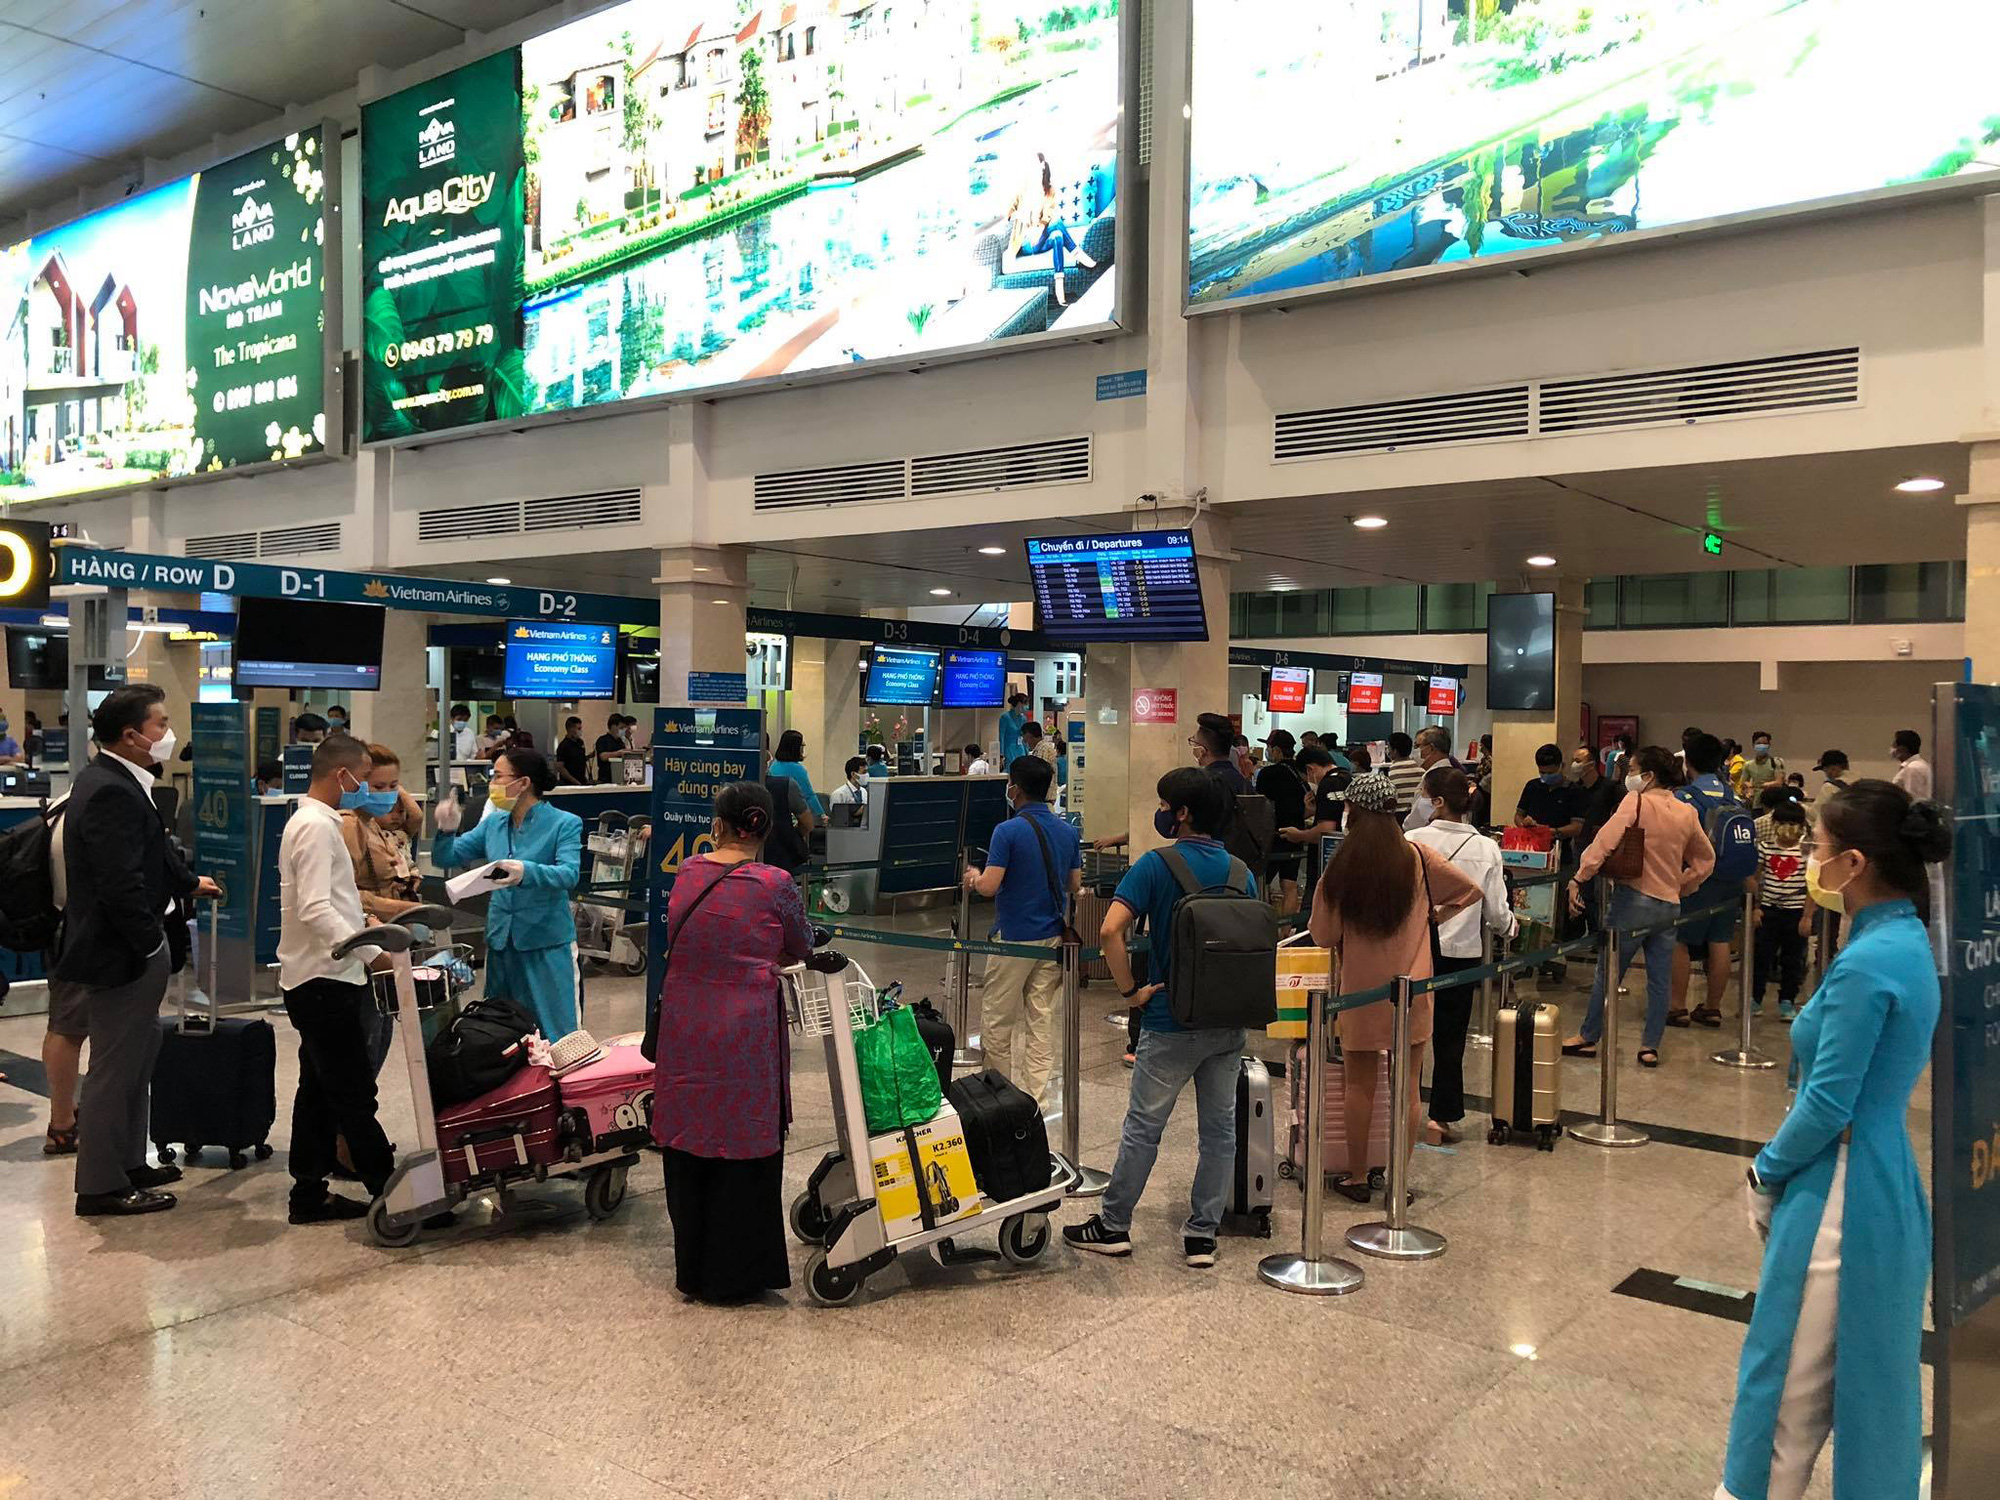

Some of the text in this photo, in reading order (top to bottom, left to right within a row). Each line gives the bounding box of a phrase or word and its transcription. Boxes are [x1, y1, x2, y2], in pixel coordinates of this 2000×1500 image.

[419, 140, 456, 163] LAND
[383, 172, 496, 227] AquaCity
[232, 223, 275, 250] LAND
[199, 256, 311, 315] NovaWorld
[436, 332, 455, 354] 79
[455, 328, 474, 350] 79
[475, 323, 494, 345] 79
[213, 334, 297, 367] The Tropicana
[1091, 539, 1143, 550] Departures
[1167, 536, 1189, 545] 09:14
[71, 556, 236, 590] HÀNG / ROW D
[281, 570, 325, 598] D-1
[539, 593, 577, 616] D-2
[884, 622, 908, 640] D-3
[958, 628, 980, 645] D-4
[534, 663, 588, 674] Economy Class
[1276, 652, 1288, 665] D-6
[1354, 658, 1366, 670] D-7
[665, 758, 746, 779] Hãy cùng bay
[198, 790, 229, 828] 40
[1734, 824, 1751, 840] ila
[1965, 938, 1992, 971] CHO
[932, 1137, 963, 1152] K2.360
